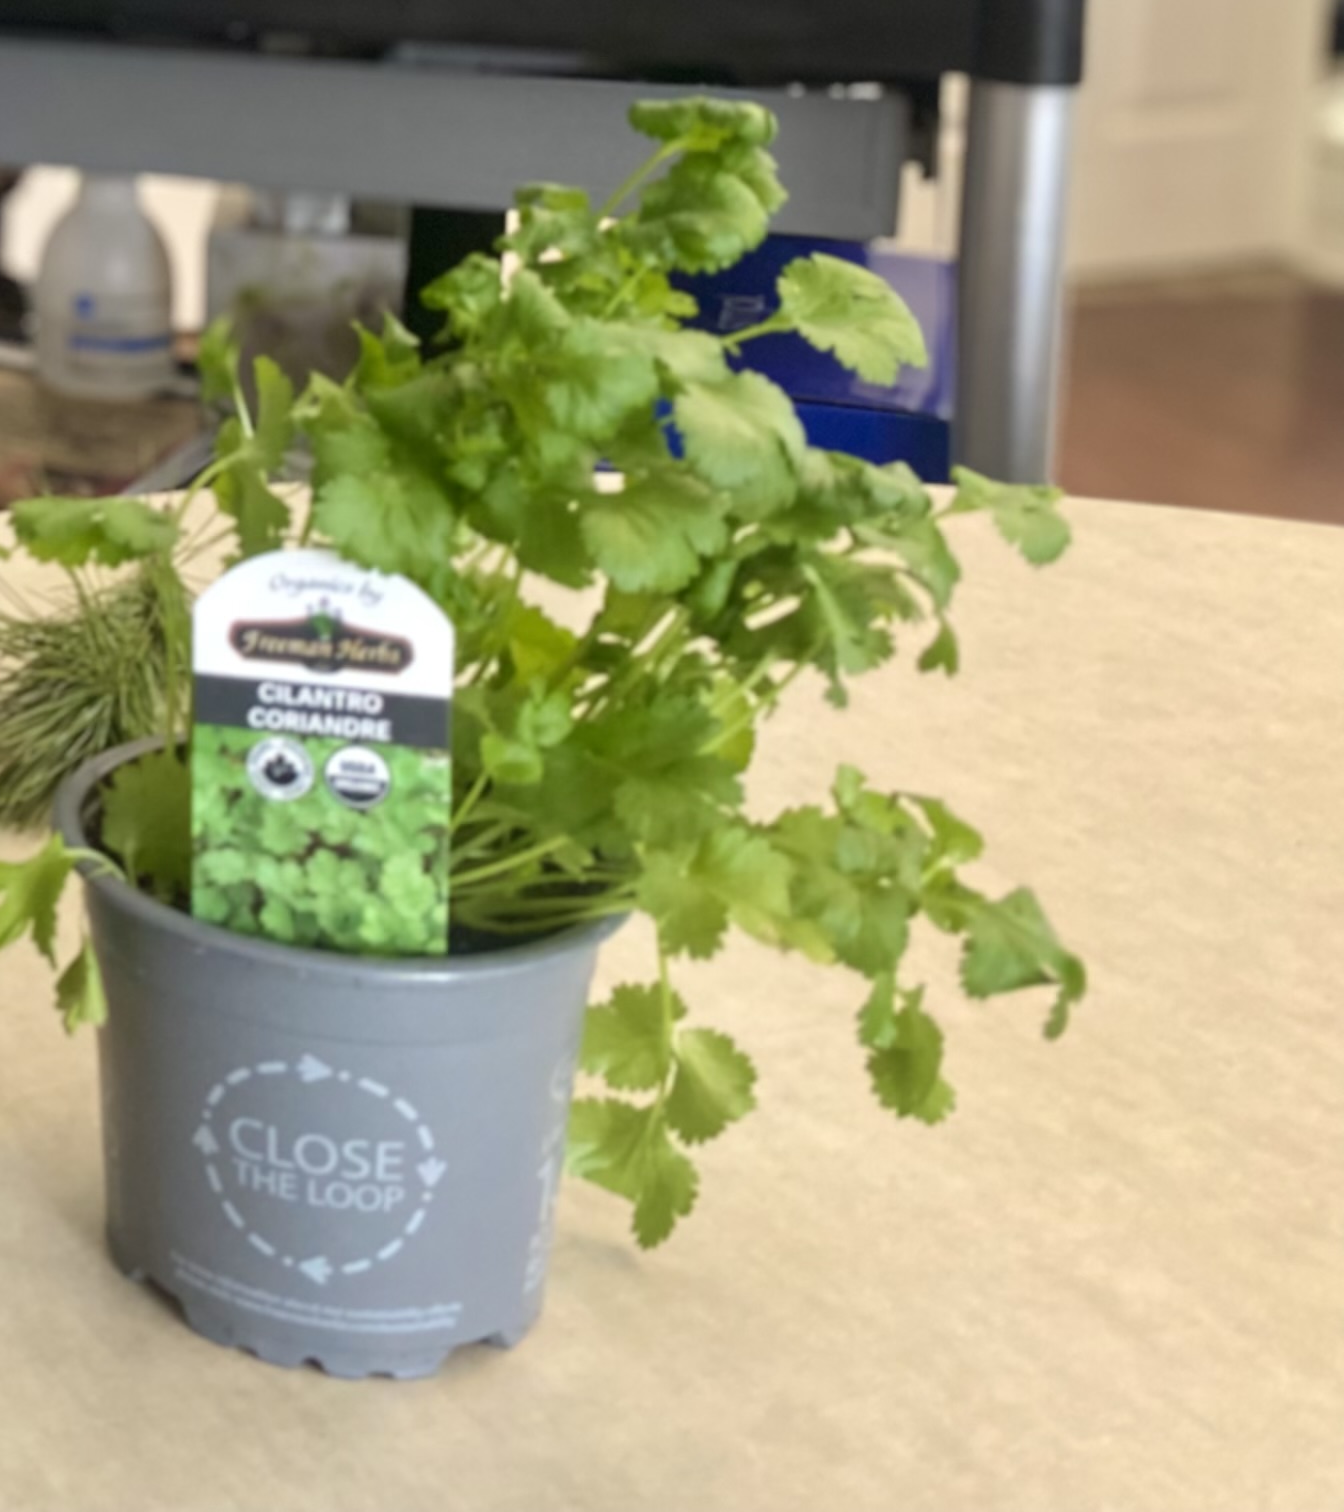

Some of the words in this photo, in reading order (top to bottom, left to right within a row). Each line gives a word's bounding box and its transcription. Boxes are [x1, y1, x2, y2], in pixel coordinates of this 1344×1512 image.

[269, 572, 354, 598] Organics
[358, 579, 384, 607] by
[257, 681, 384, 715] CILANTRO
[246, 705, 393, 742] CORIANDRE
[229, 1116, 406, 1181] CLOSE
[232, 1156, 299, 1202] THE
[307, 1178, 405, 1222] LOOP
